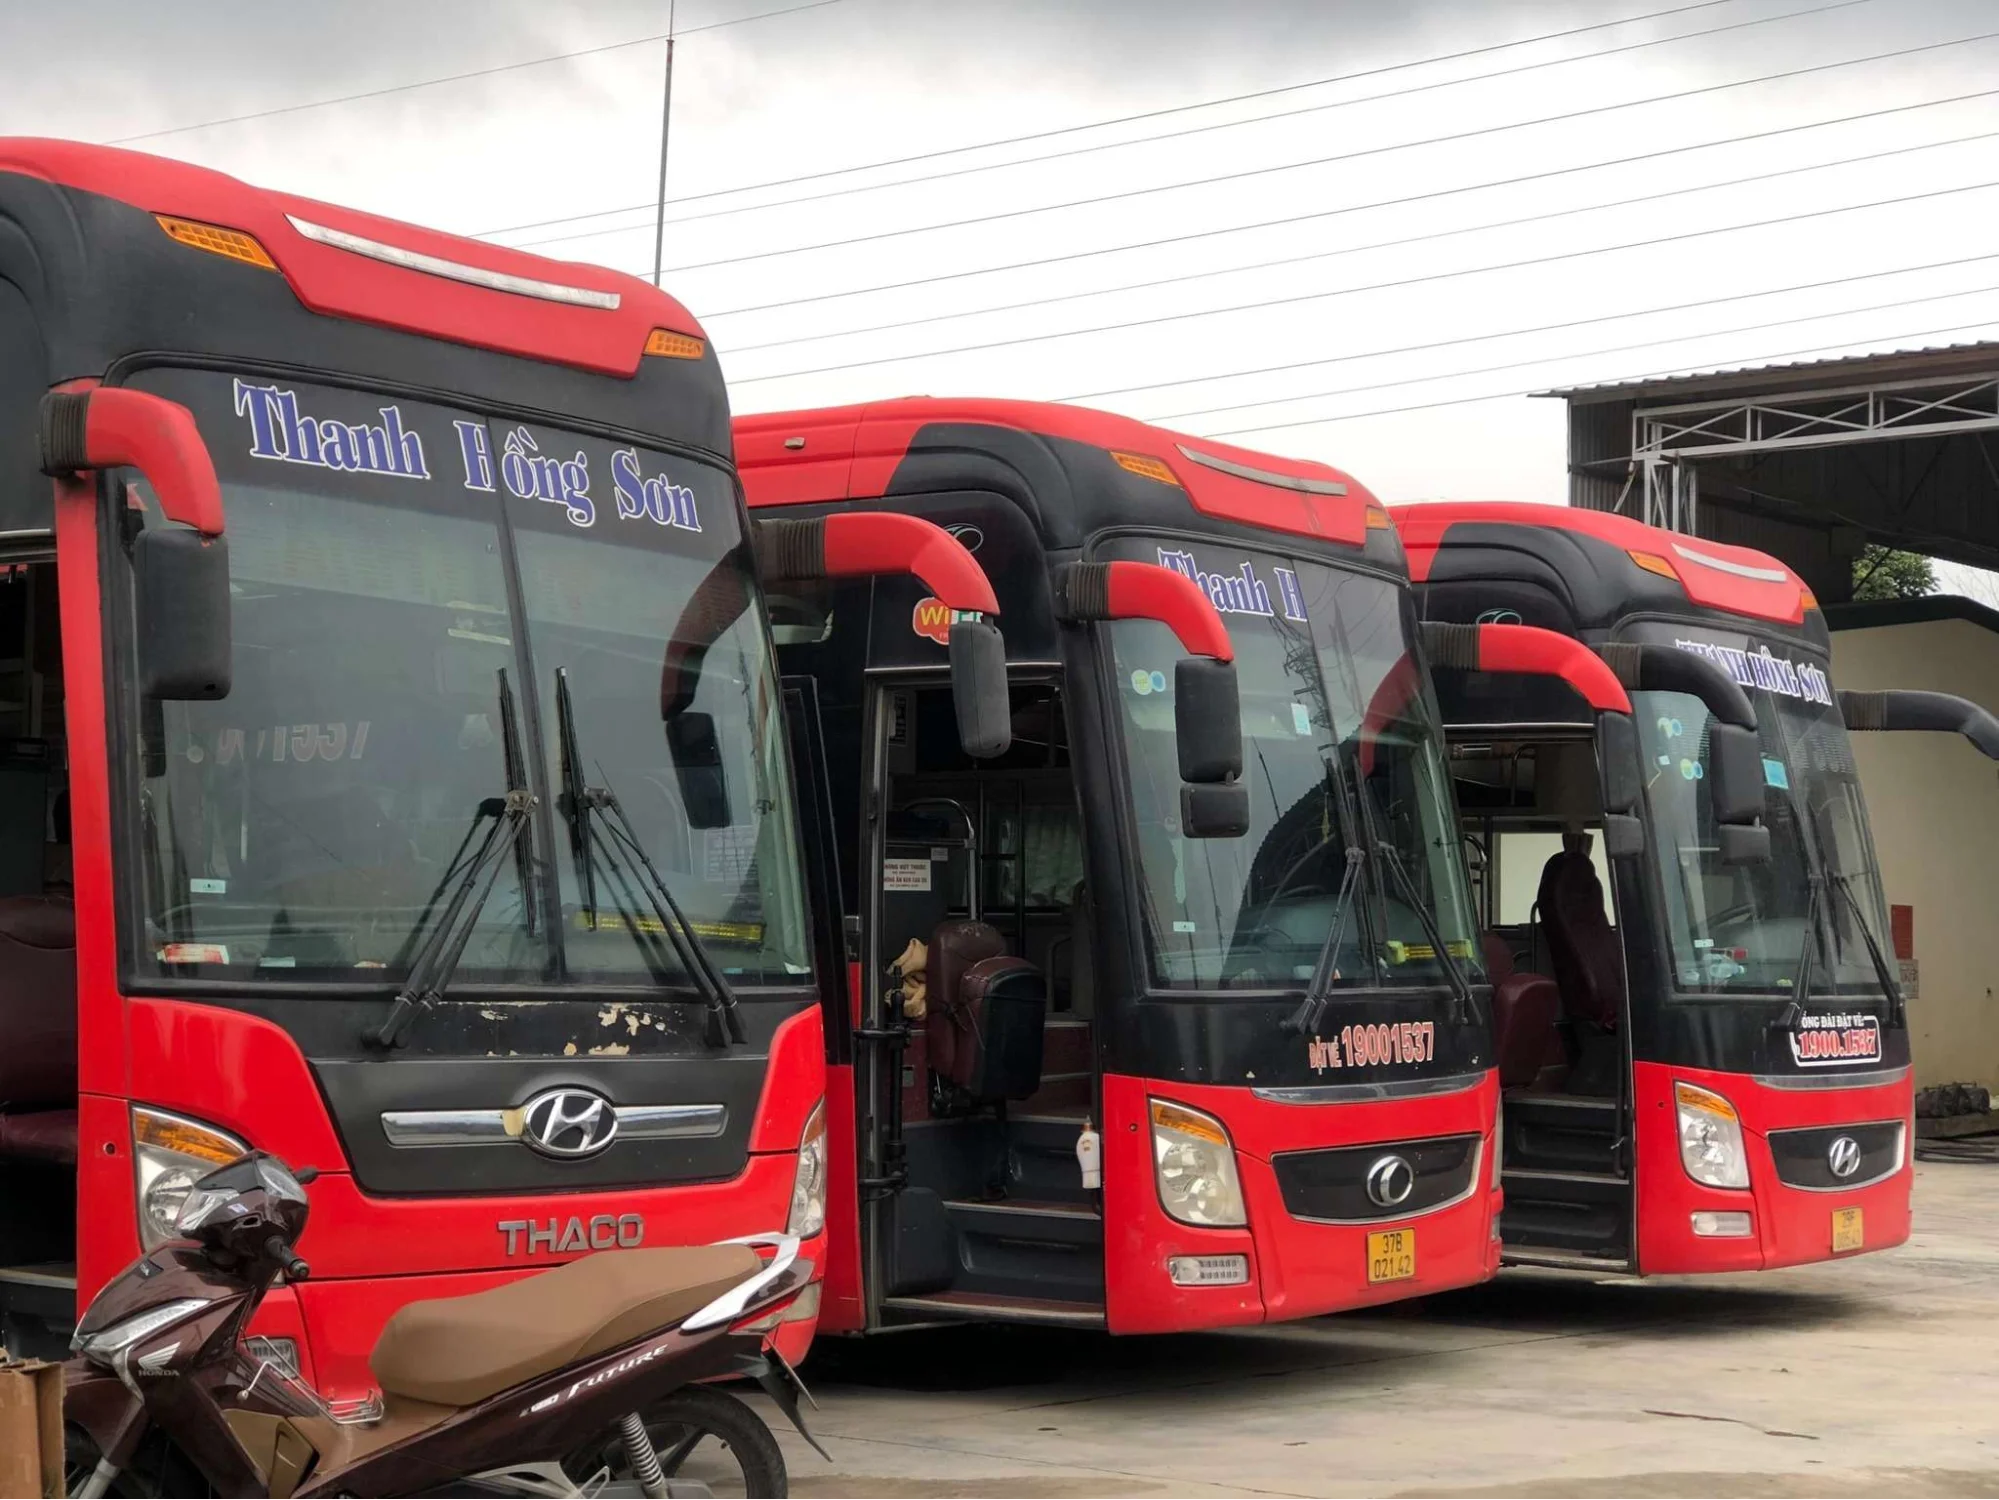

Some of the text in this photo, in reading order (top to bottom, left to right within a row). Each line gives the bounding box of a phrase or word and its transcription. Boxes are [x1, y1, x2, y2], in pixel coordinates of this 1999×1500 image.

[233, 377, 703, 533] Thanh Hồng Sơn
[1341, 1021, 1435, 1068] 19001537
[498, 1213, 645, 1256] THACO
[1383, 1232, 1403, 1254] 37B
[1374, 1254, 1412, 1279] 021.42
[138, 1369, 180, 1377] HONDA
